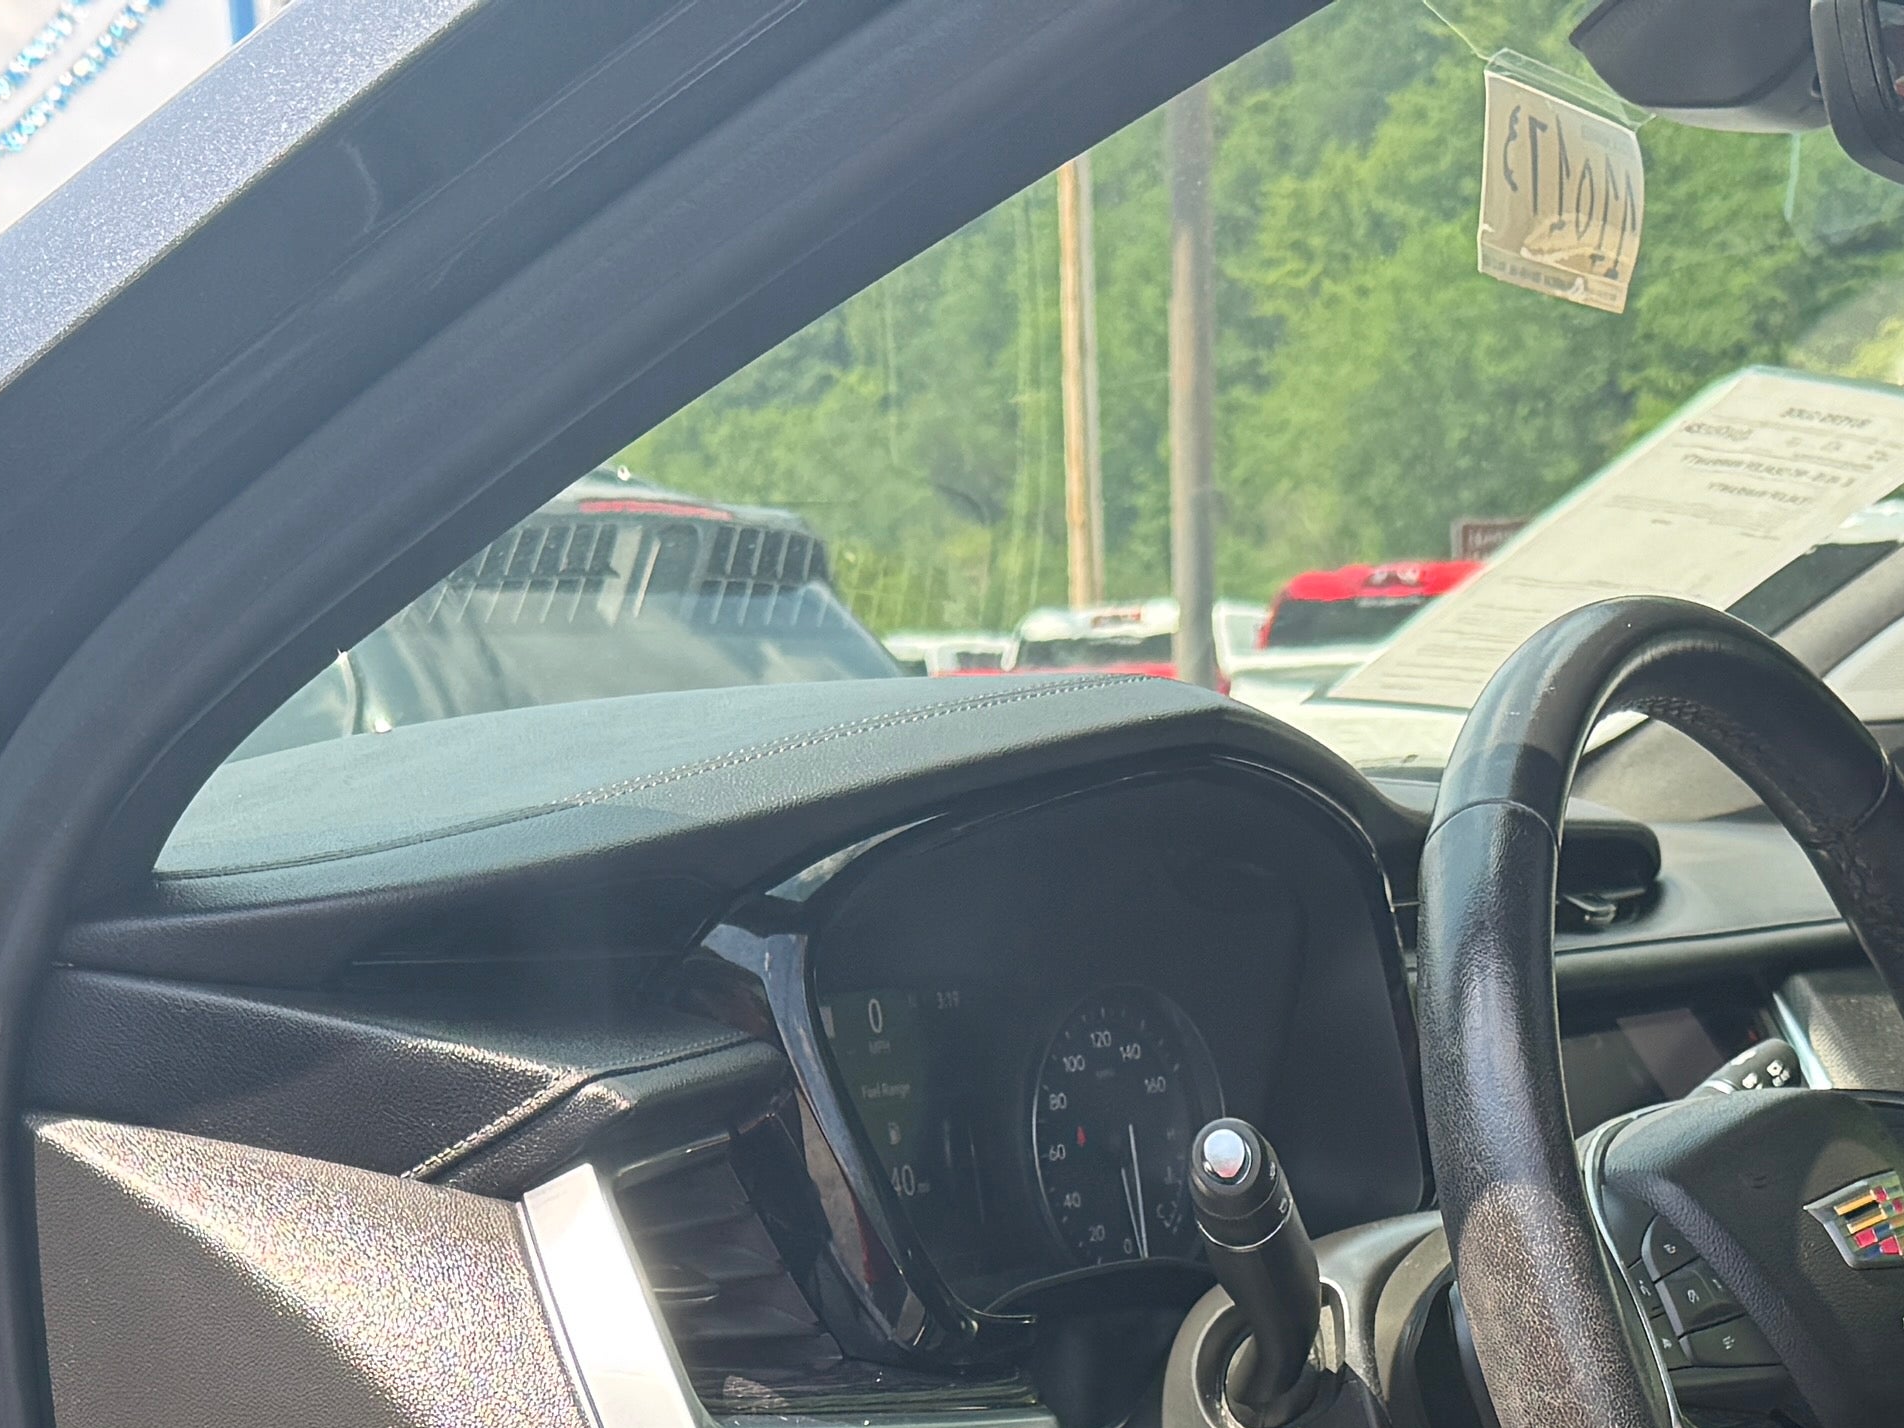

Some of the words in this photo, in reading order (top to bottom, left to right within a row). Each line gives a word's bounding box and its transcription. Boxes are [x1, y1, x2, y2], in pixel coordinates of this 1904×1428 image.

[868, 998, 883, 1033] 0
[1090, 1031, 1112, 1048] 120
[1119, 1043, 1141, 1061] 140
[1063, 1056, 1085, 1072] 100
[1144, 1077, 1166, 1093] 160
[1049, 1094, 1067, 1110] 80
[1049, 1144, 1066, 1161] 60
[1063, 1191, 1081, 1208] 40
[1088, 1225, 1106, 1242] 20
[1124, 1238, 1132, 1254] 0
